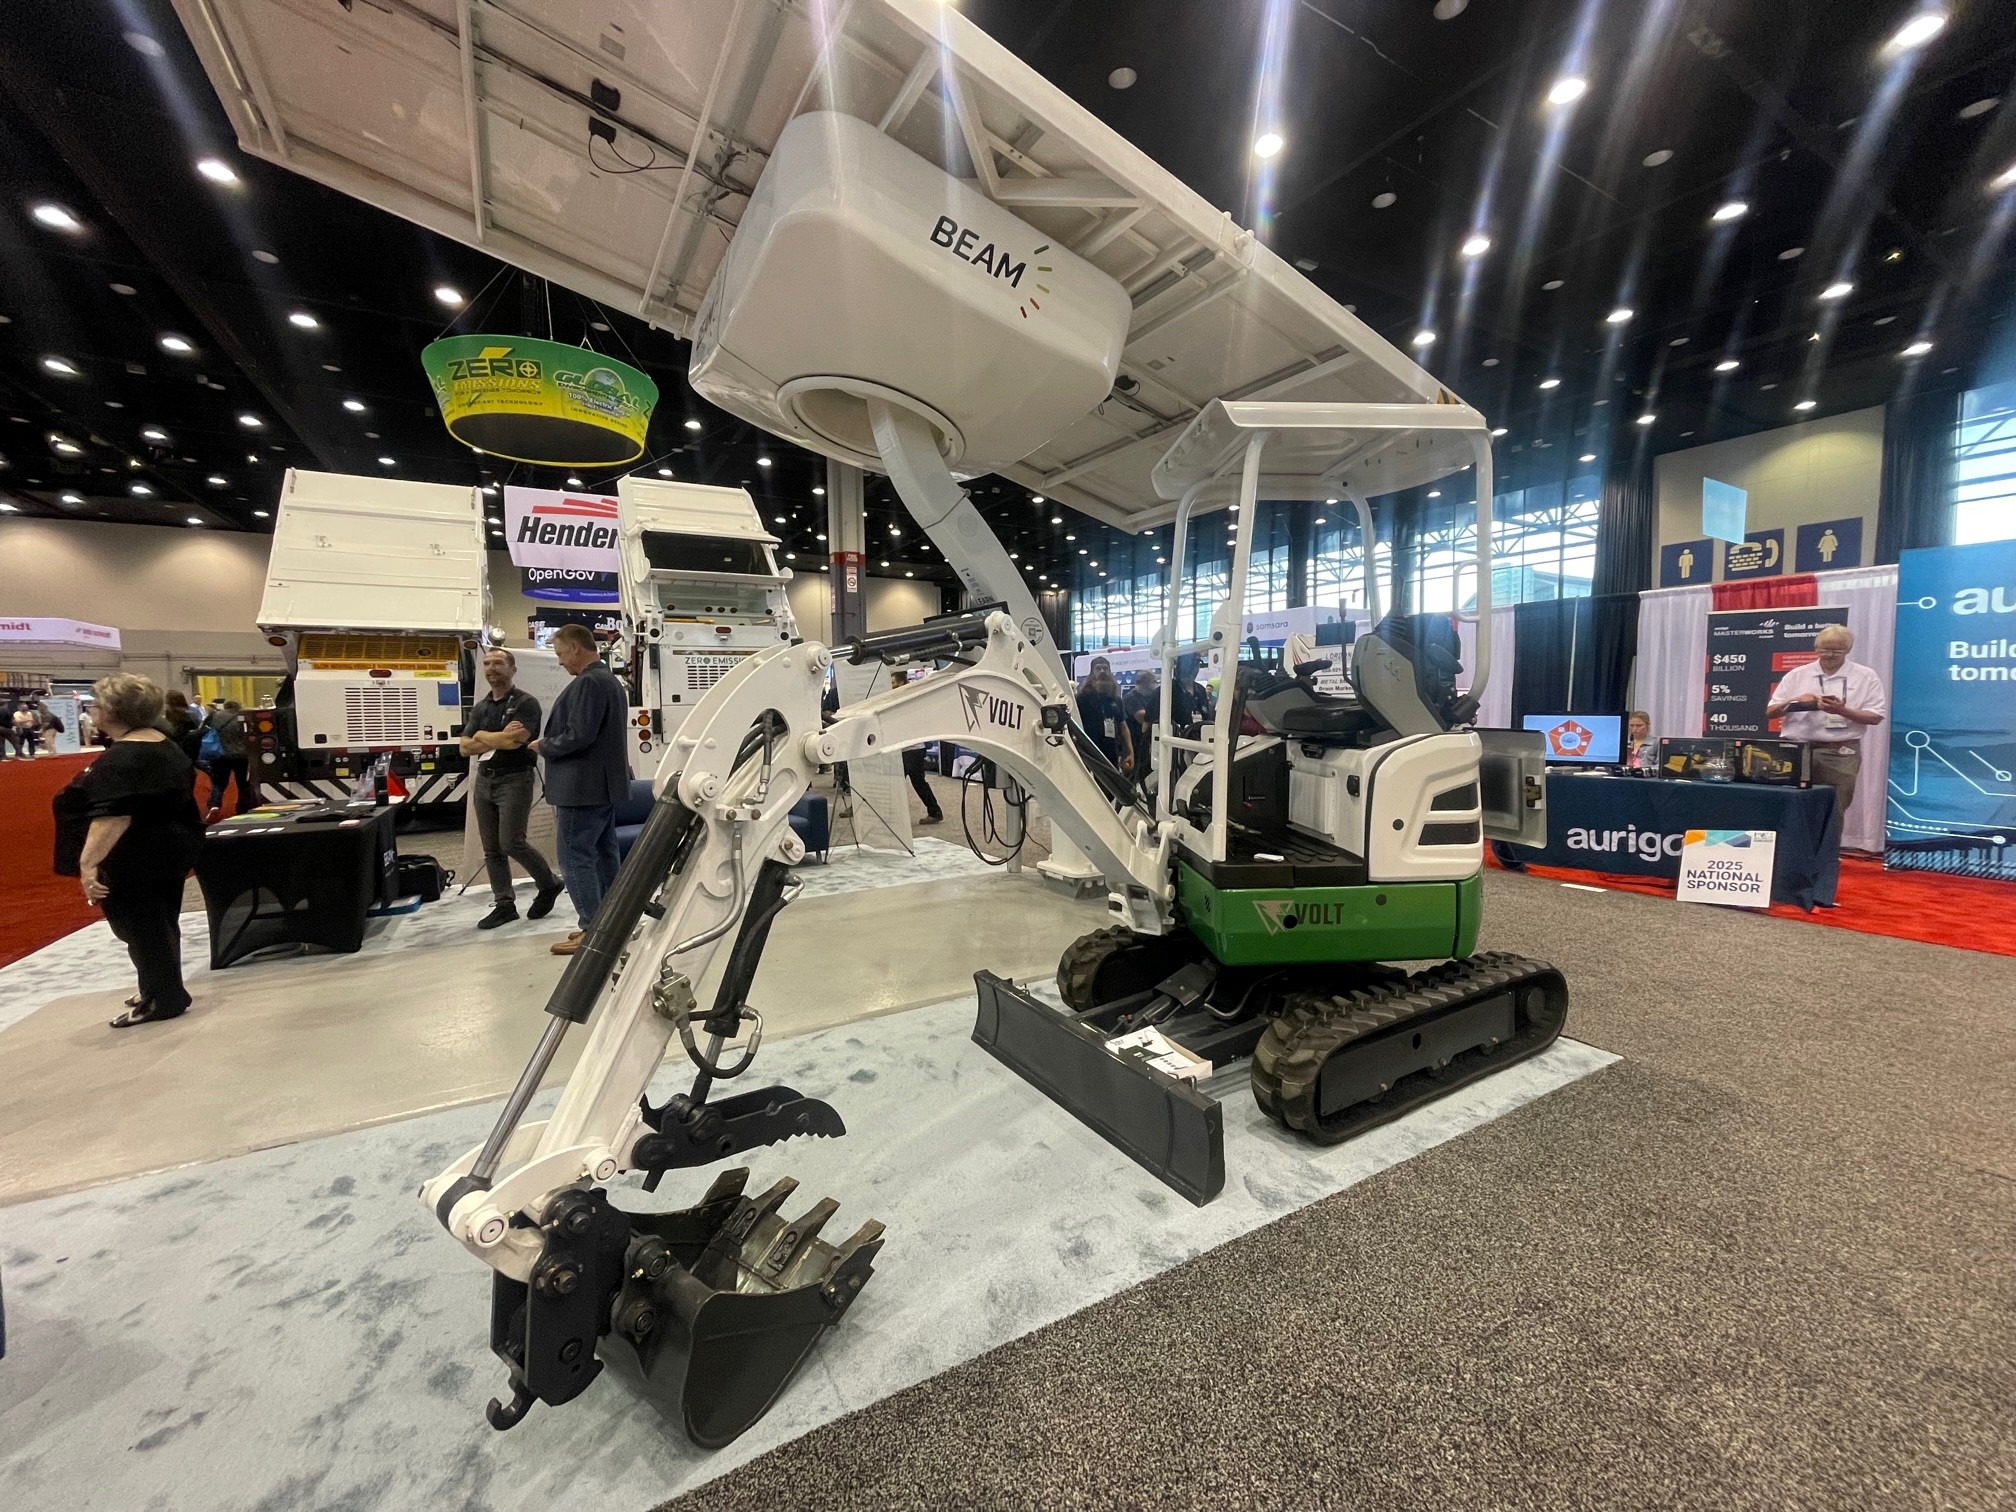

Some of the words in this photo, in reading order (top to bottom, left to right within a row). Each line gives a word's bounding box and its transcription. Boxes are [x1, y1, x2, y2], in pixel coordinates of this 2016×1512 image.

[930, 215, 1027, 288] BEAM
[455, 378, 541, 391] EMISSIONS
[528, 567, 595, 583] OpenGov
[1255, 621, 1289, 631] samsara
[1713, 628, 1775, 637] MASTERWORKS
[1712, 653, 1747, 665] $450
[1712, 665, 1745, 673] BILLION
[1711, 684, 1731, 694] 5%
[1710, 694, 1748, 702] SAVINGS
[990, 696, 1025, 730] VOLT
[1709, 713, 1728, 723] 40
[1709, 724, 1759, 732] THOUSAND
[1707, 860, 1744, 871] 2025
[1686, 869, 1764, 883] NATIONAL
[1686, 879, 1761, 894] SPONSOR
[1294, 902, 1345, 925] VOLT
